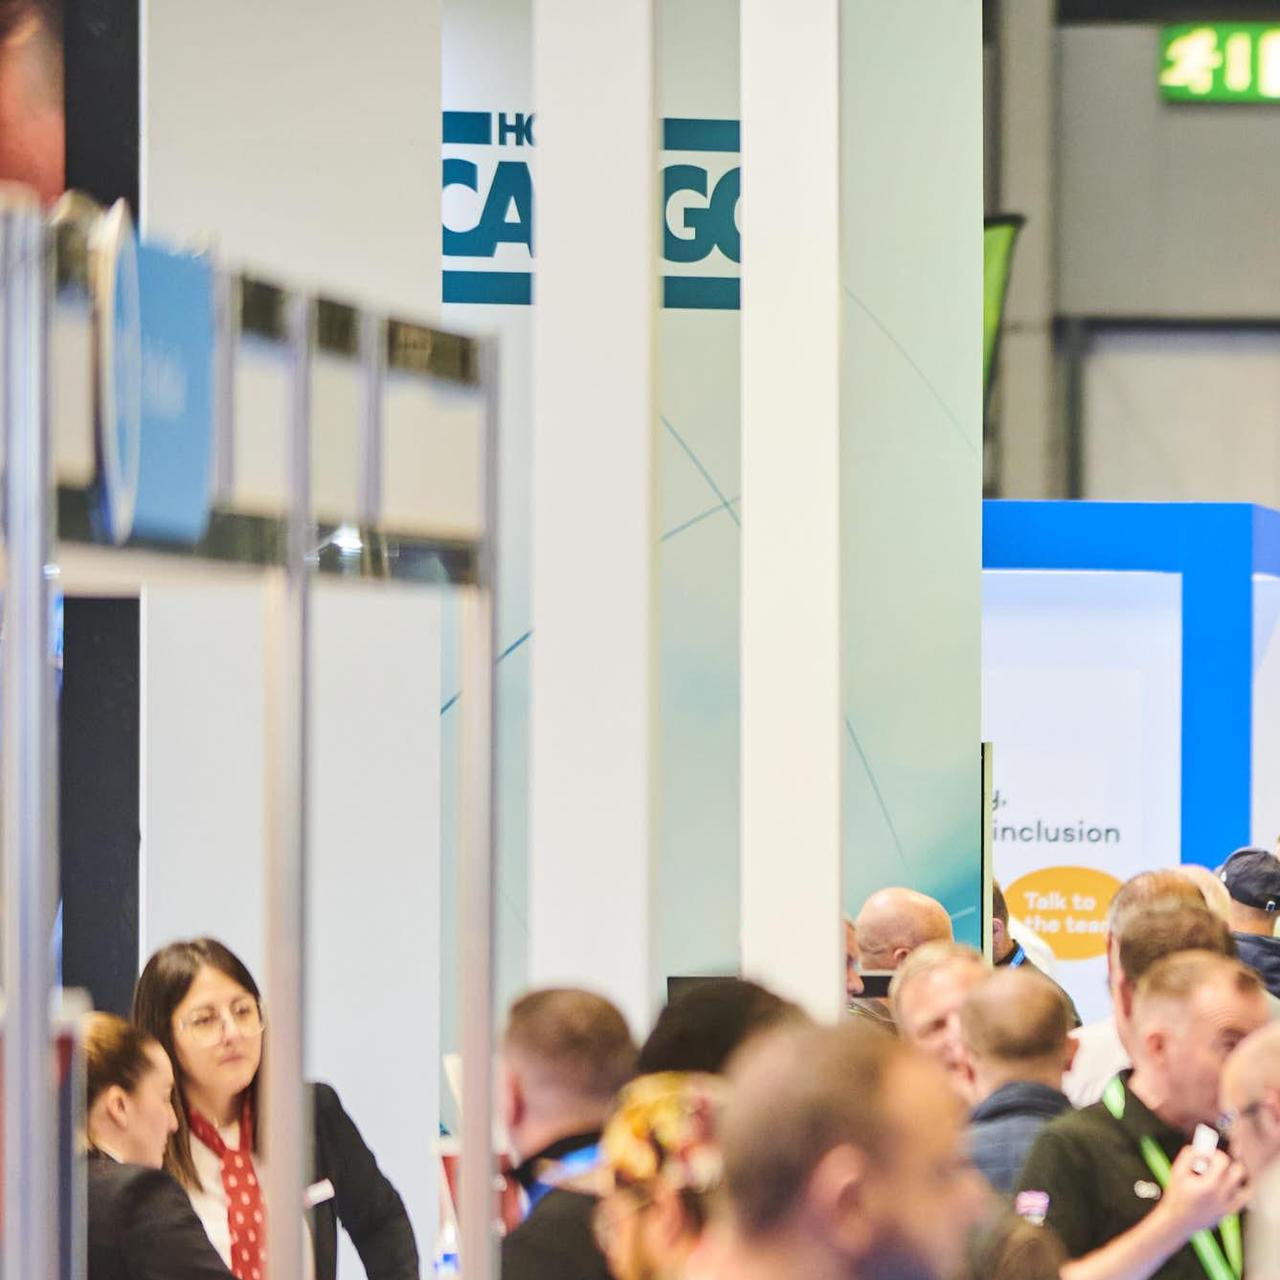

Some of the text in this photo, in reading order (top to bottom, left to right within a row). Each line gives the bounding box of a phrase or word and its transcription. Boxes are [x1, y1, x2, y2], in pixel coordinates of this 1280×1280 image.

[993, 820, 1121, 843] inclusion
[1023, 890, 1097, 911] Talk to
